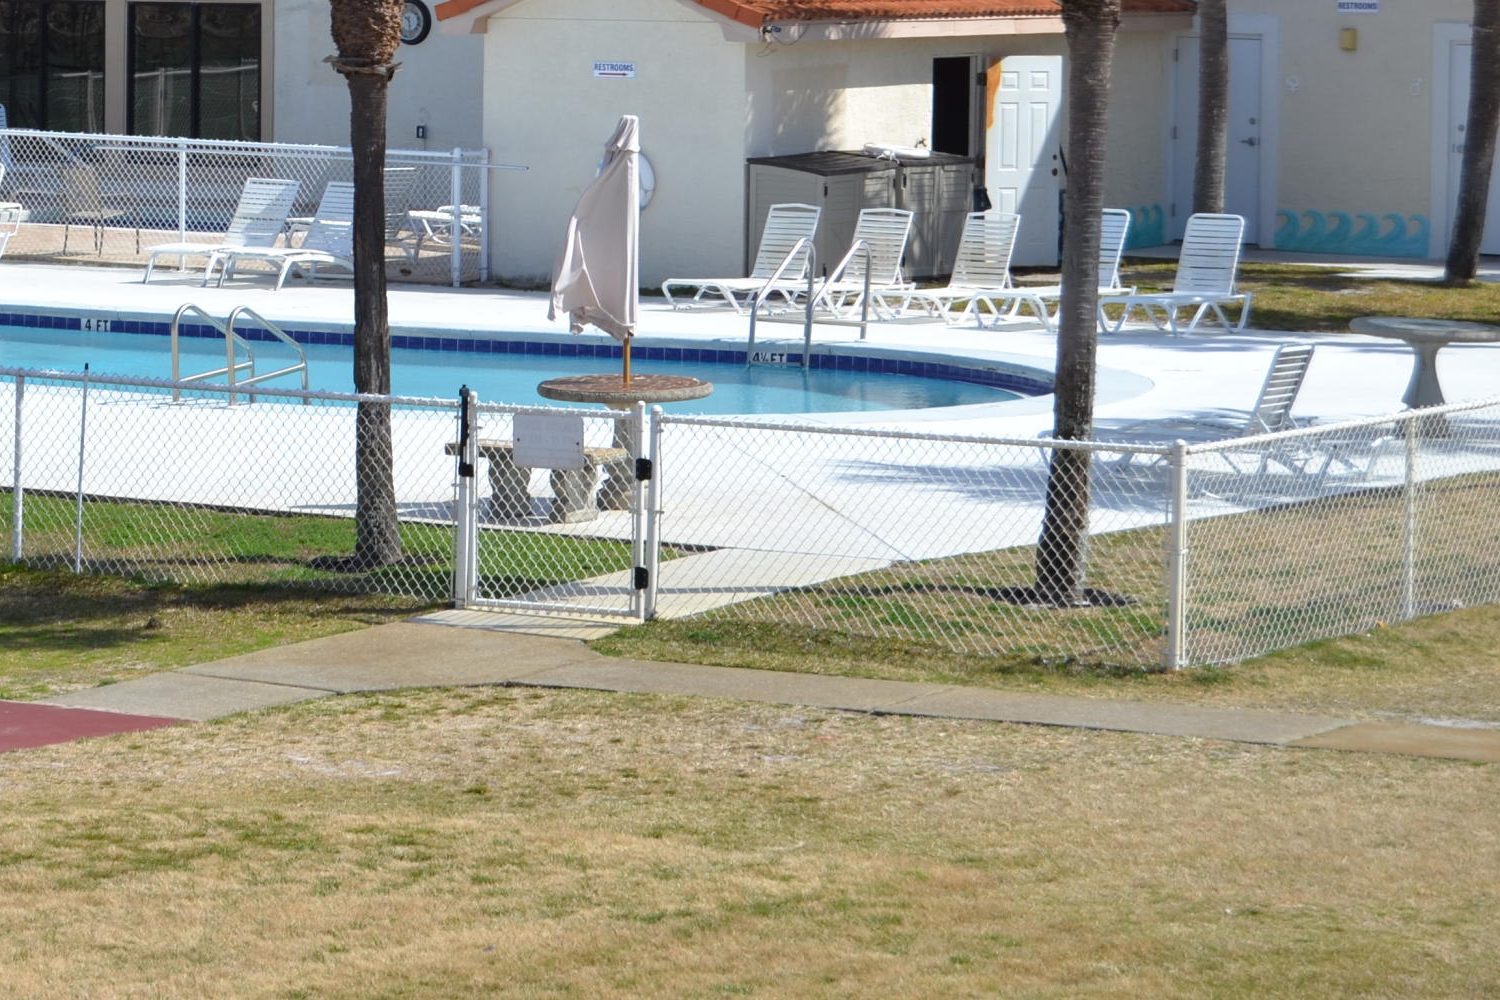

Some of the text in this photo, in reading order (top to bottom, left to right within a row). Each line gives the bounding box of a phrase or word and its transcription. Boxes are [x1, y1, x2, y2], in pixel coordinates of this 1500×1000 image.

[1338, 2, 1377, 10] RESTROOMS
[594, 63, 634, 72] RESTROOMS
[85, 318, 92, 331] 4
[770, 352, 785, 363] FT
